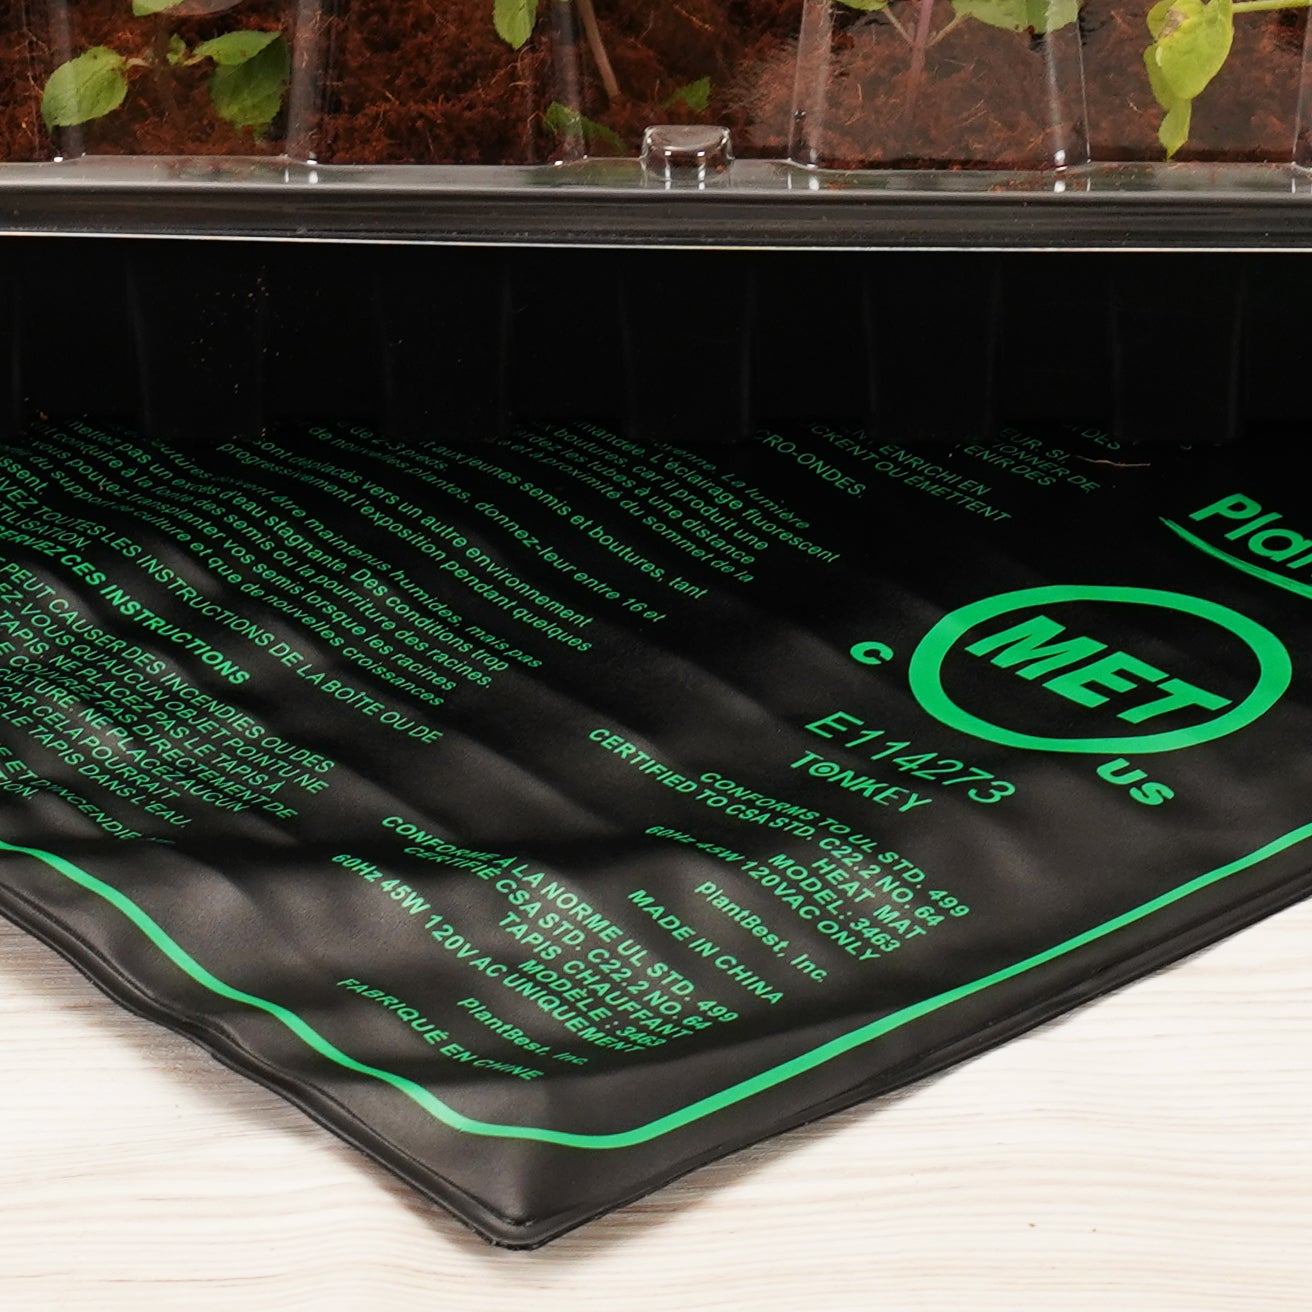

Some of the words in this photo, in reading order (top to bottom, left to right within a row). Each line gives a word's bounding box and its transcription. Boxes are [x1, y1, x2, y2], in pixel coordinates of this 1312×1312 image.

[431, 445, 465, 461] aux
[459, 457, 521, 484] jeunes
[520, 483, 572, 516] semis
[570, 515, 593, 530] et
[668, 577, 709, 599] tant
[558, 449, 588, 463] les
[586, 461, 635, 488] tubes
[634, 487, 650, 497] à
[648, 496, 683, 519] une
[681, 519, 755, 564] distance
[649, 455, 743, 510] L'éclairage
[742, 509, 841, 563] fluorescent
[874, 461, 907, 478] OU
[879, 445, 960, 483] ENRICHI
[957, 481, 989, 495] EN
[65, 458, 130, 497] pouvez
[126, 493, 226, 538] transplanter
[223, 539, 255, 564] vos
[252, 563, 304, 594] semis
[302, 592, 366, 636] lorsque
[365, 634, 394, 655] les
[391, 653, 456, 690] racines
[114, 443, 152, 464] pas
[149, 463, 174, 480] un
[219, 491, 266, 518] d'eau
[350, 568, 389, 596] Des
[385, 596, 474, 652] conditions
[470, 649, 509, 671] trop
[347, 500, 447, 560] l'exposition
[440, 560, 517, 609] pendant
[512, 608, 592, 651] quelques
[362, 482, 399, 505] vers
[398, 502, 423, 518] un
[420, 516, 468, 548] autre
[465, 547, 593, 628] environnement
[474, 502, 576, 571] donnez-leur
[573, 572, 620, 600] entre
[623, 598, 648, 612] 16
[643, 611, 667, 622] et
[0, 563, 56, 599] PEUT
[48, 599, 128, 652] CAUSER
[121, 646, 167, 674] DES
[160, 674, 265, 739] INCENDIES
[260, 736, 296, 754] OU
[288, 749, 335, 773] DES
[33, 505, 107, 536] TOUTES
[100, 533, 143, 557] LES
[136, 555, 275, 646] INSTRUCTIONS
[268, 643, 304, 667] DE
[296, 664, 325, 685] LA
[320, 679, 385, 716] BOÎTE
[379, 711, 415, 731] OU
[407, 725, 442, 743] DE
[60, 554, 107, 585] CES
[99, 584, 251, 684] INSTRUCTIONS
[965, 614, 1233, 725] MET
[1, 710, 33, 726] LE
[27, 724, 85, 765] TAPIS
[78, 764, 138, 797] DANS
[130, 796, 192, 826] L'EAU.
[70, 645, 169, 701] QU'AUCUN
[164, 701, 231, 738] OBJET
[223, 737, 298, 778] POINTU
[293, 773, 329, 793] NE
[804, 710, 1017, 806] E114273
[588, 728, 698, 793] CERTIFIED
[695, 789, 729, 807] TO
[725, 804, 772, 824] CSA
[768, 817, 816, 840] STD.
[818, 837, 881, 878] C22.2
[875, 875, 914, 909] NO.
[914, 905, 944, 926] 64
[788, 749, 934, 816] TONKEY
[1097, 757, 1174, 808] US
[645, 826, 696, 843] 60Hz
[697, 843, 745, 862] 45W
[741, 861, 821, 920] 120VAC
[817, 920, 880, 960] ONLY
[700, 772, 821, 821] CONFORMS
[819, 817, 851, 834] TO
[848, 834, 877, 853] UL
[877, 851, 926, 887] STD.
[929, 890, 970, 917] 499
[768, 853, 852, 919] MODEL:
[849, 917, 901, 952] 3463
[811, 858, 875, 902] HEAT
[873, 905, 926, 938] MAT
[331, 854, 382, 882] 60Hz
[381, 879, 431, 914] 45W
[425, 914, 479, 958] 120V
[470, 957, 508, 977] AC
[503, 973, 644, 1052] UNIQUEMENT
[382, 816, 498, 861] CONFORME
[511, 864, 544, 887] LA
[540, 882, 624, 942] NORME
[617, 939, 648, 966] UL
[646, 962, 695, 1000] STD.
[697, 1000, 739, 1022] 499
[403, 842, 502, 880] CERTIFIÉ
[495, 878, 541, 918] CSA
[538, 912, 585, 950] STD.
[587, 948, 649, 994] C22.2
[643, 990, 682, 1019] NO.
[681, 1015, 712, 1030] 64
[499, 911, 563, 960] TAPIS
[562, 960, 692, 1038] CHAUFFANT
[627, 889, 696, 940] MADE
[689, 938, 719, 957] IN
[714, 955, 783, 1004] CHINA
[694, 882, 789, 957] PlantBest,
[791, 954, 827, 981] Inc.
[337, 978, 448, 1044] FABRIQUÉ
[439, 1043, 477, 1062] EN
[473, 1059, 544, 1080] CHINE
[458, 998, 550, 1056] PlantBest,
[554, 1052, 589, 1065] Inc.
[518, 959, 612, 1022] MODÈLE
[616, 1026, 667, 1046] 3463
